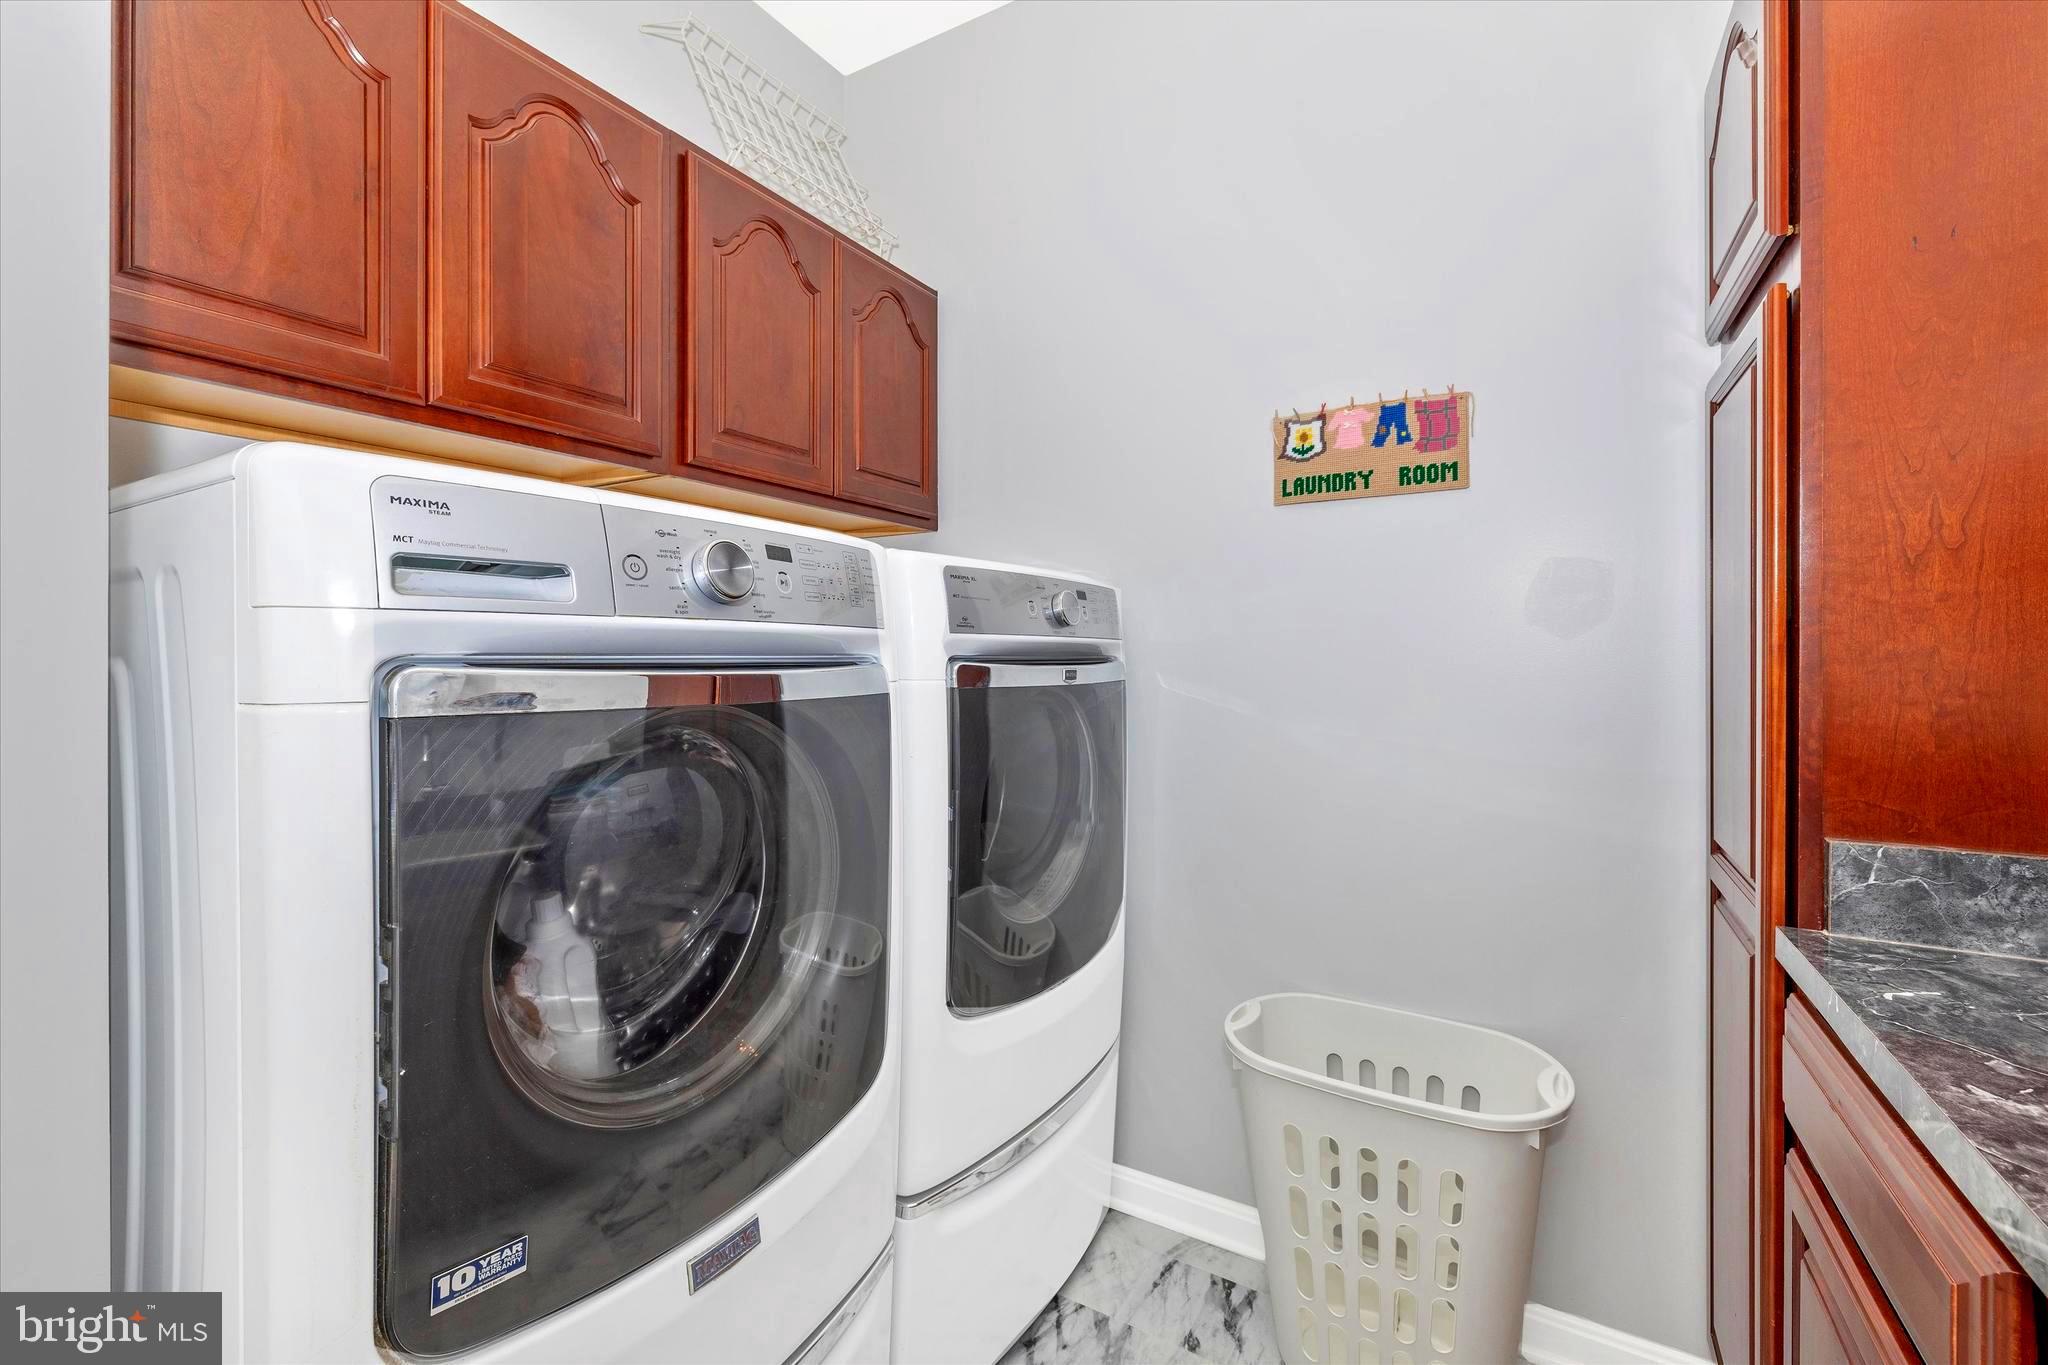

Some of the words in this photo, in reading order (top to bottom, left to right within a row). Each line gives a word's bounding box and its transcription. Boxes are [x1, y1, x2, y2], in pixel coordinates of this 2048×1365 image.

[1282, 470, 1373, 497] LAUNDRY
[1399, 461, 1458, 486] ROOM
[390, 495, 450, 510] MAXIMA
[392, 534, 414, 543] MCT
[437, 1265, 476, 1300] 10
[479, 1242, 523, 1268] YEAR
[479, 1260, 502, 1277] LIMITED
[504, 1251, 522, 1264] PARTS
[479, 1256, 522, 1280] WARRANTY
